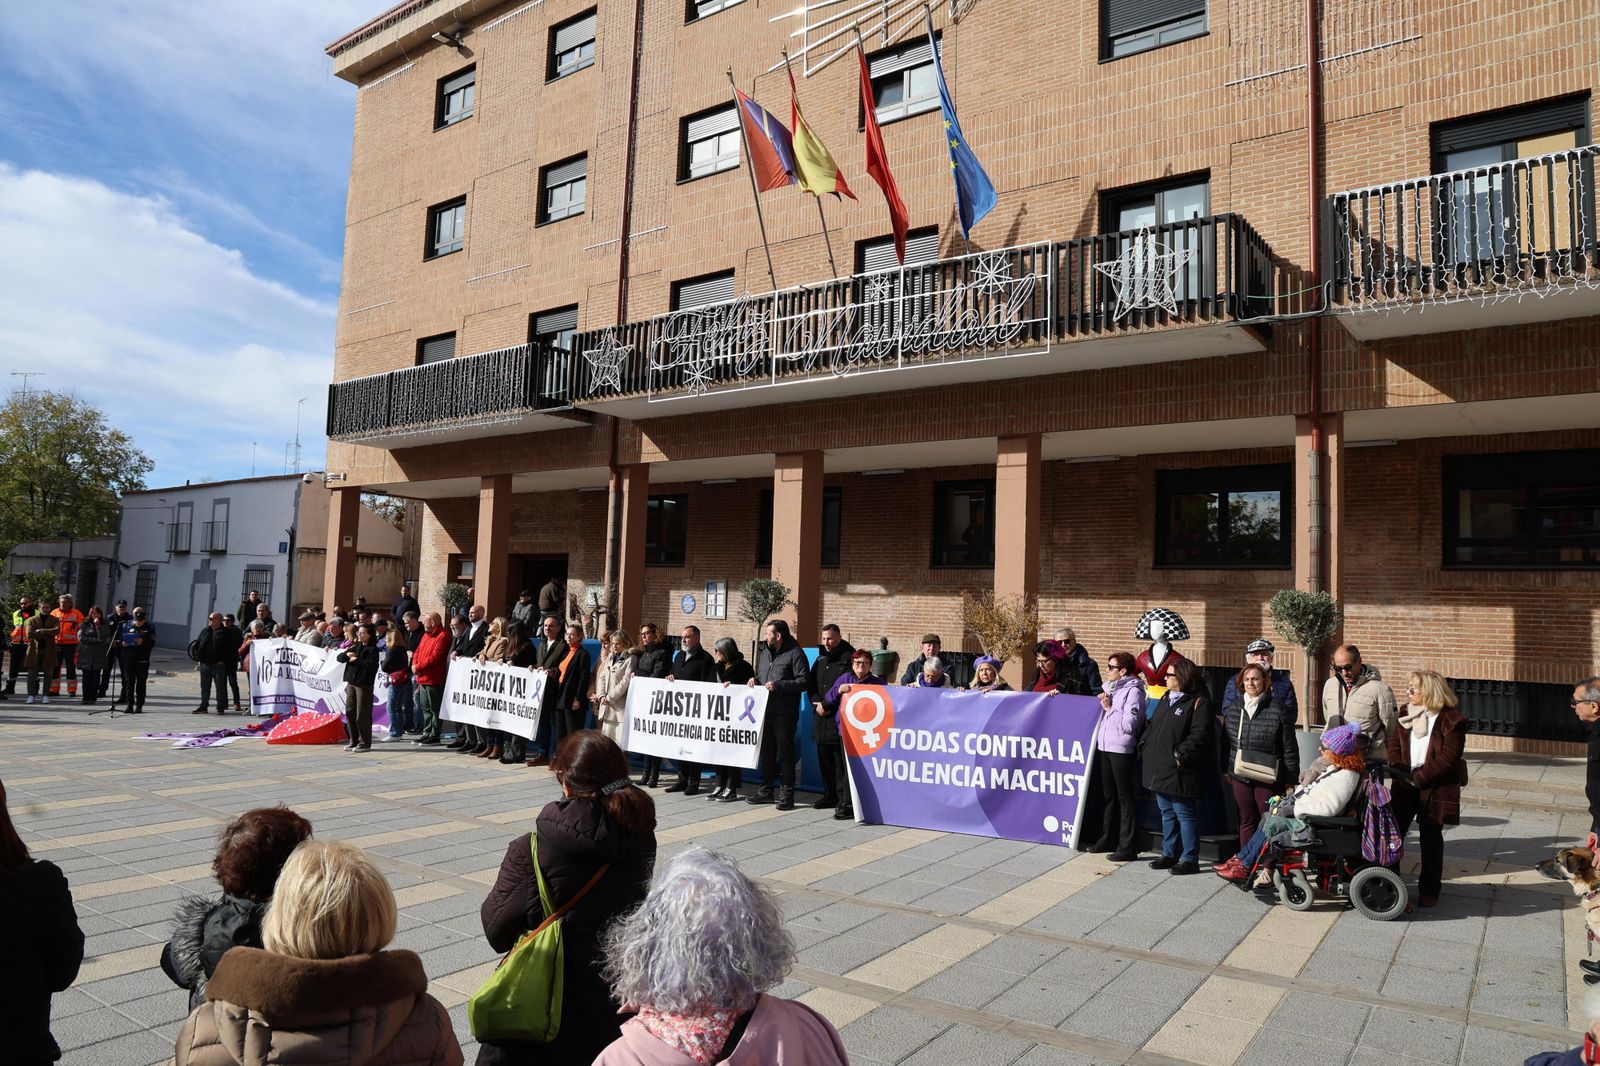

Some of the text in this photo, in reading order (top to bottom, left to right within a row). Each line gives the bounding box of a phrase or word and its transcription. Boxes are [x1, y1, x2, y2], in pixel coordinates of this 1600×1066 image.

[652, 273, 1036, 376] Feliz Navidad
[470, 669, 527, 699] ¡BASTA YA!
[462, 693, 467, 705] A
[468, 694, 475, 707] LA
[509, 702, 516, 715] DE
[649, 690, 731, 722] ¡BASTA YA!
[633, 717, 758, 746] NO A LA VIOLENCIA DE GÉNERO
[887, 727, 1085, 764] TODAS CONTRA LA
[872, 757, 986, 789] VIOLENCIA
